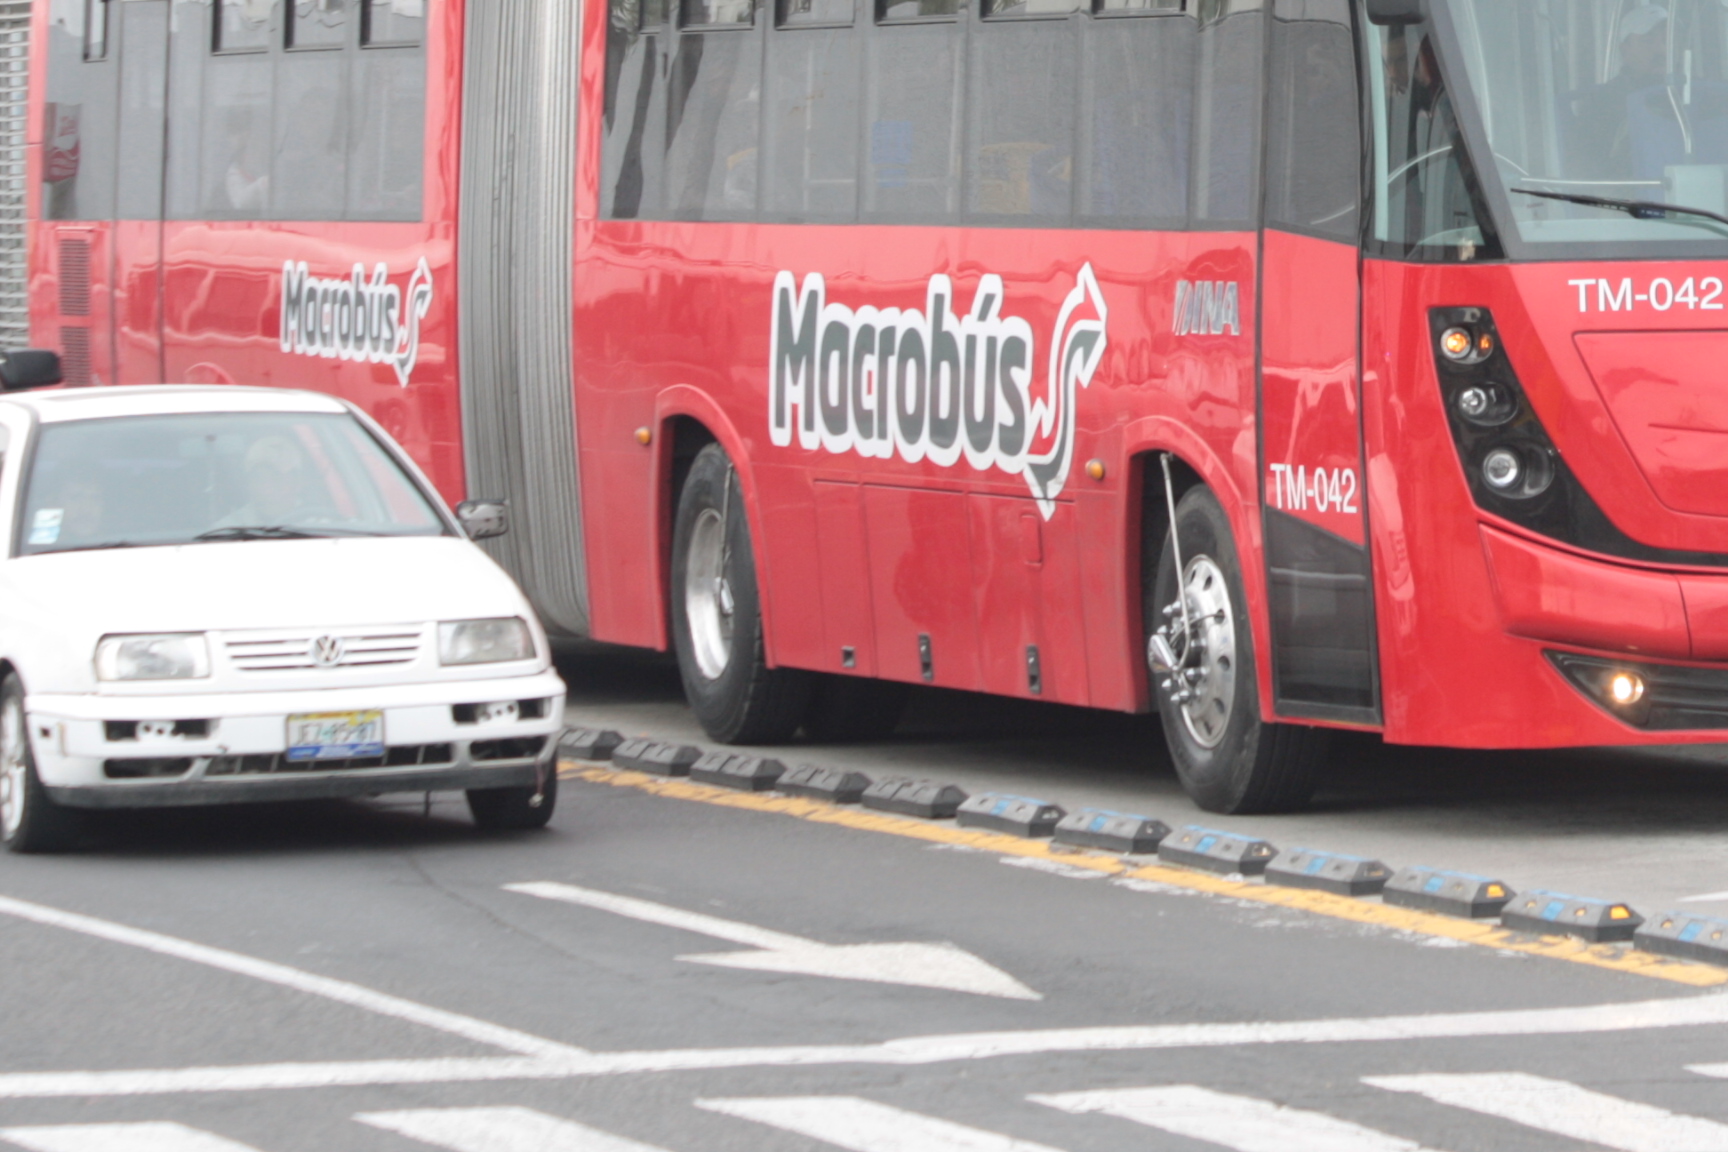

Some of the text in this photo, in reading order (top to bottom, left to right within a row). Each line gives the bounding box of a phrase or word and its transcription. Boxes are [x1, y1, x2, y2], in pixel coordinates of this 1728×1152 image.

[282, 261, 399, 362] Macrobús
[1172, 279, 1240, 336] DINA
[1567, 276, 1724, 312] TM-042
[770, 273, 1033, 472] Macrobús
[1269, 462, 1358, 515] TM-042
